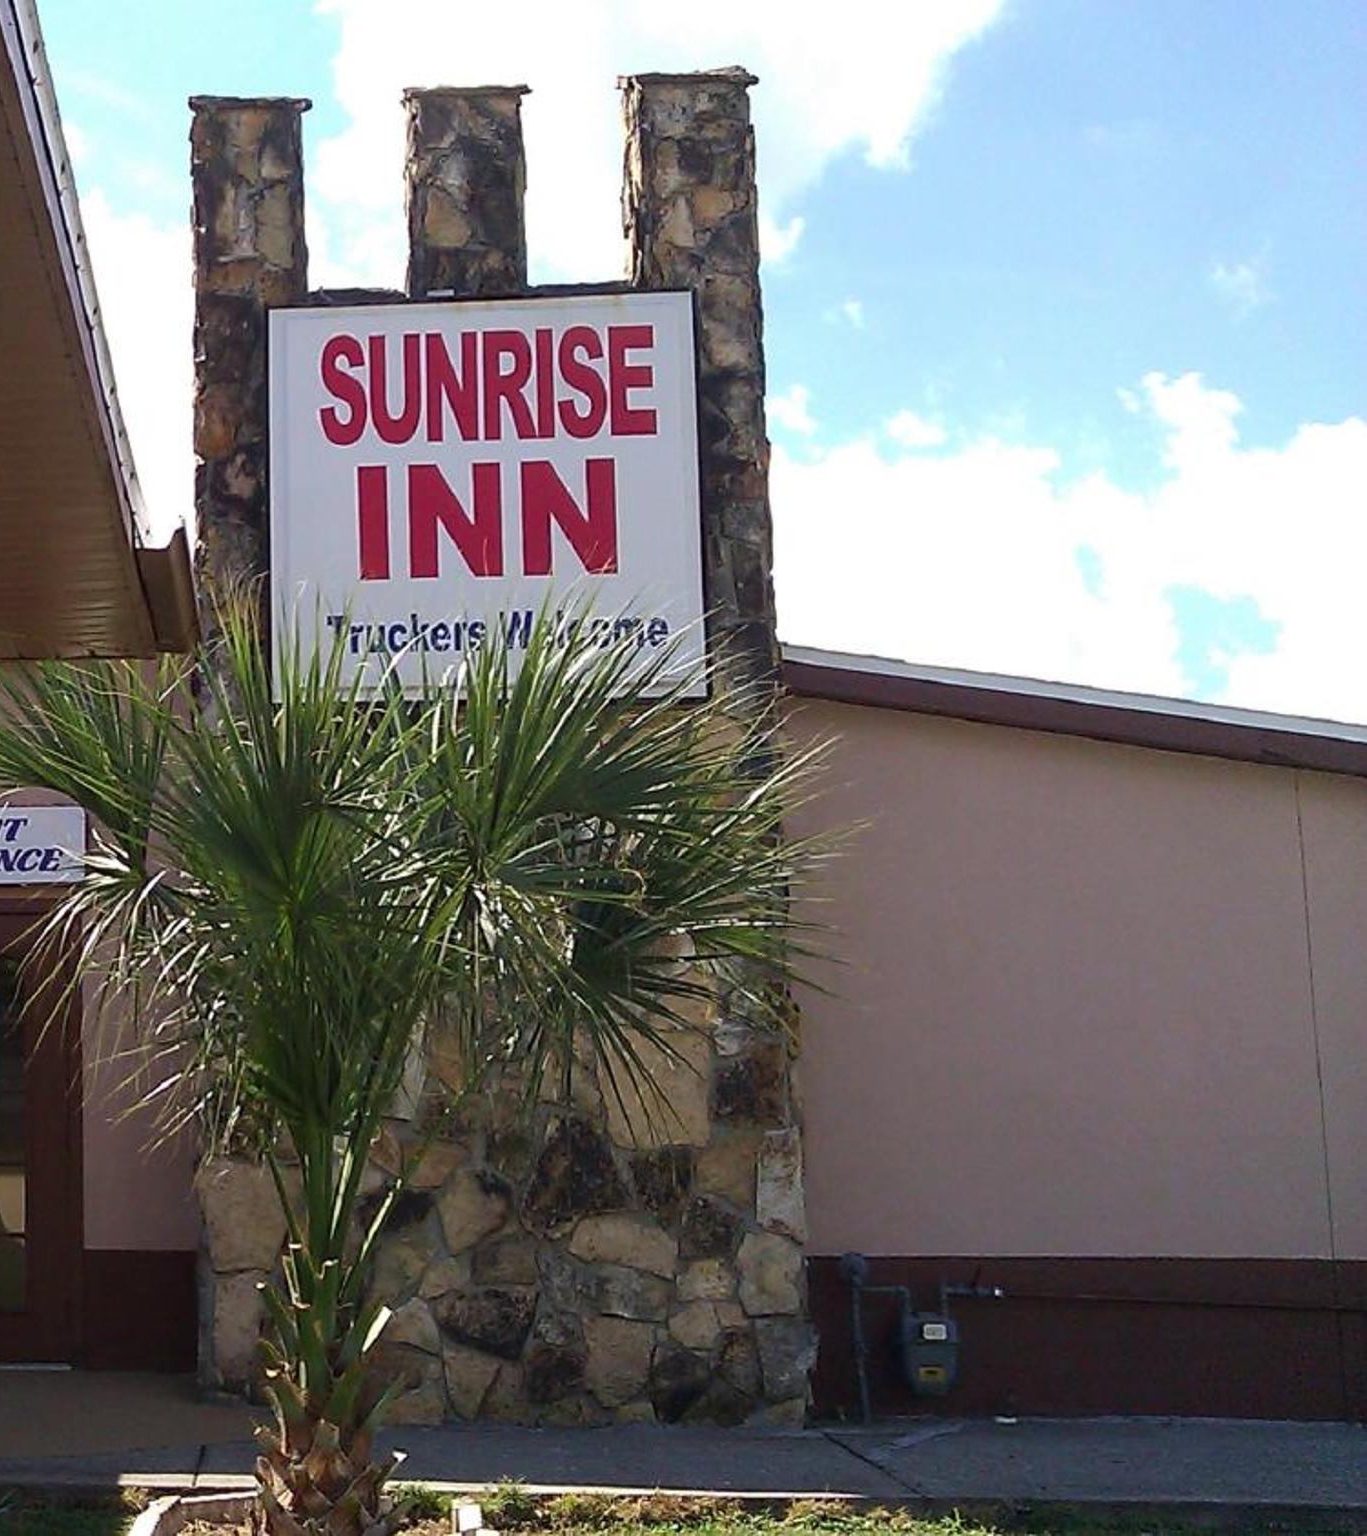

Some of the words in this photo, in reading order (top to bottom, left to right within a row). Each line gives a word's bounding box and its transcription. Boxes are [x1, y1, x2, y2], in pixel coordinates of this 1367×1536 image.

[319, 325, 658, 446] SUNRISE
[357, 457, 618, 581] INN
[326, 611, 486, 653] Truckers
[498, 610, 668, 650] Wlcome
